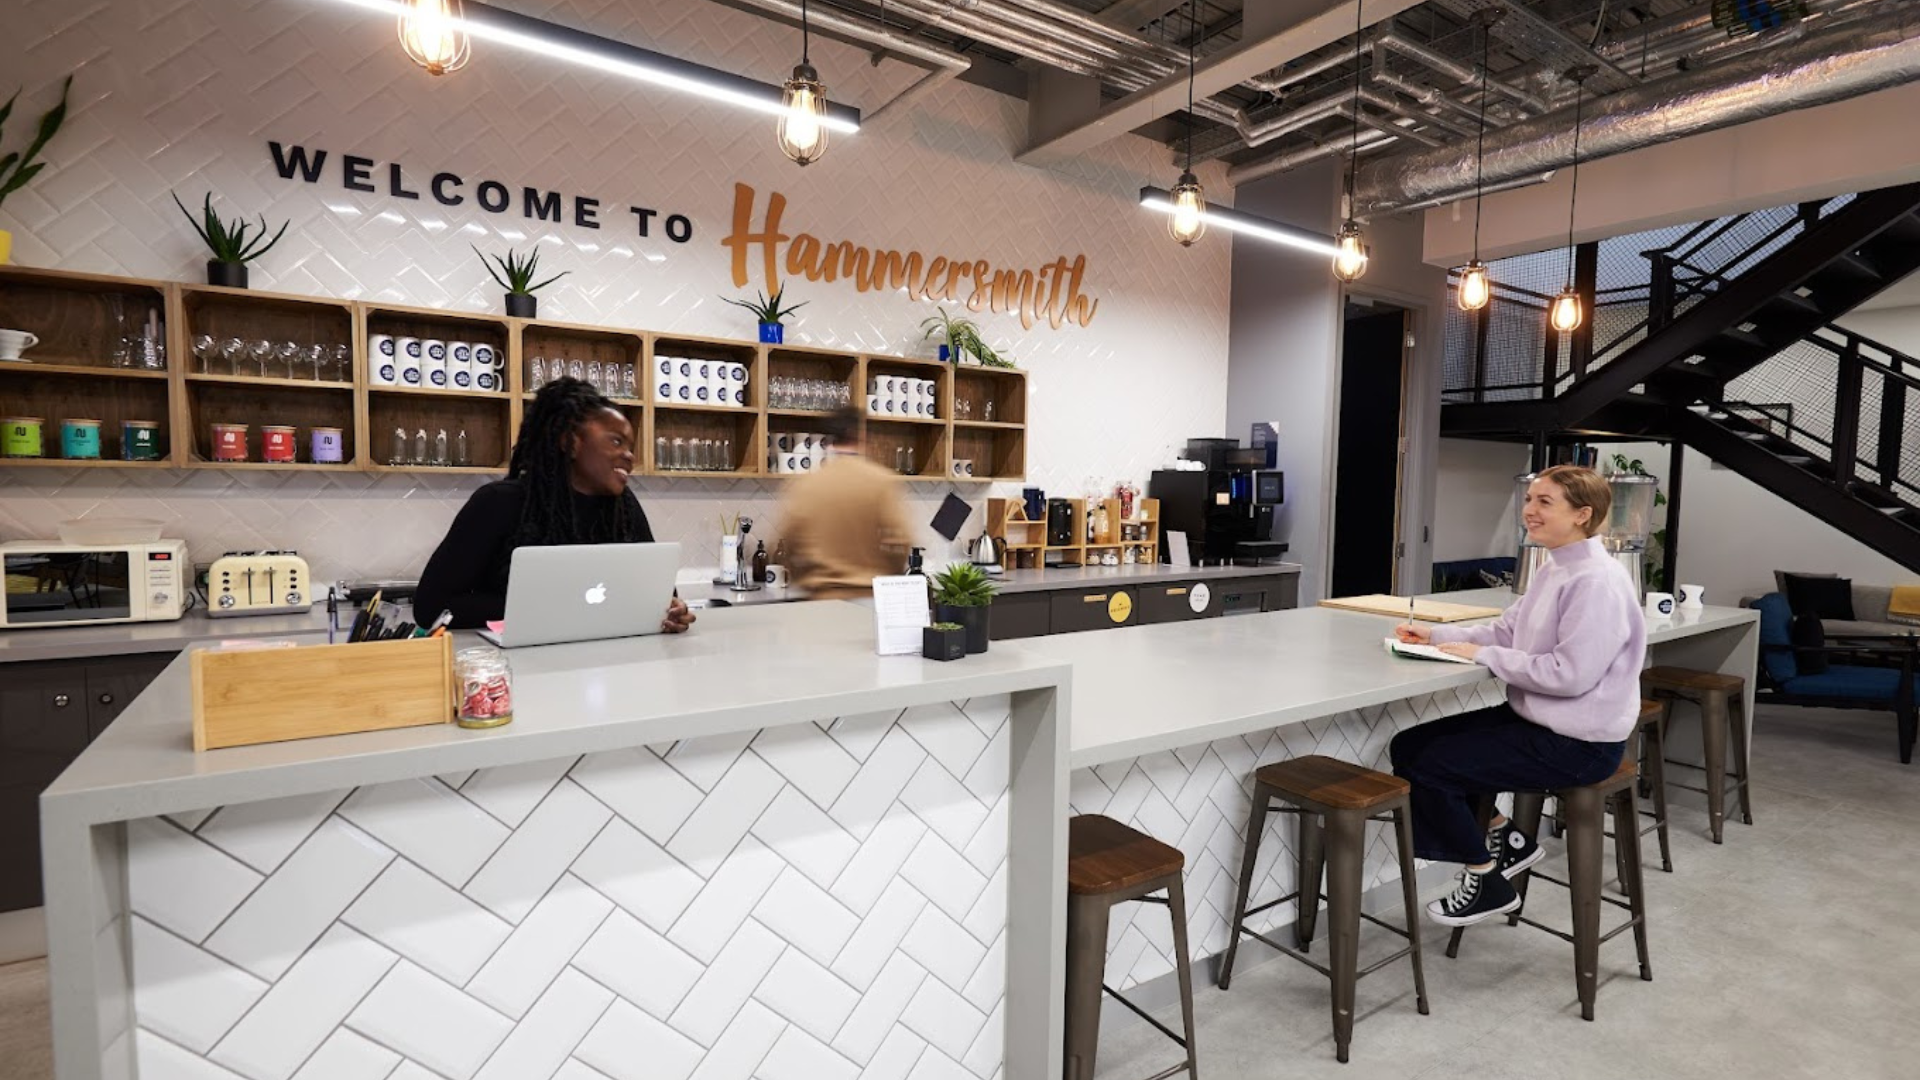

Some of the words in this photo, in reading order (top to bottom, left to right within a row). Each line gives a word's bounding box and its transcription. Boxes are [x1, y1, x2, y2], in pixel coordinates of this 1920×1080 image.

[267, 141, 601, 230] WELCOME
[630, 206, 693, 244] TO
[721, 182, 1099, 330] Hammersmith
